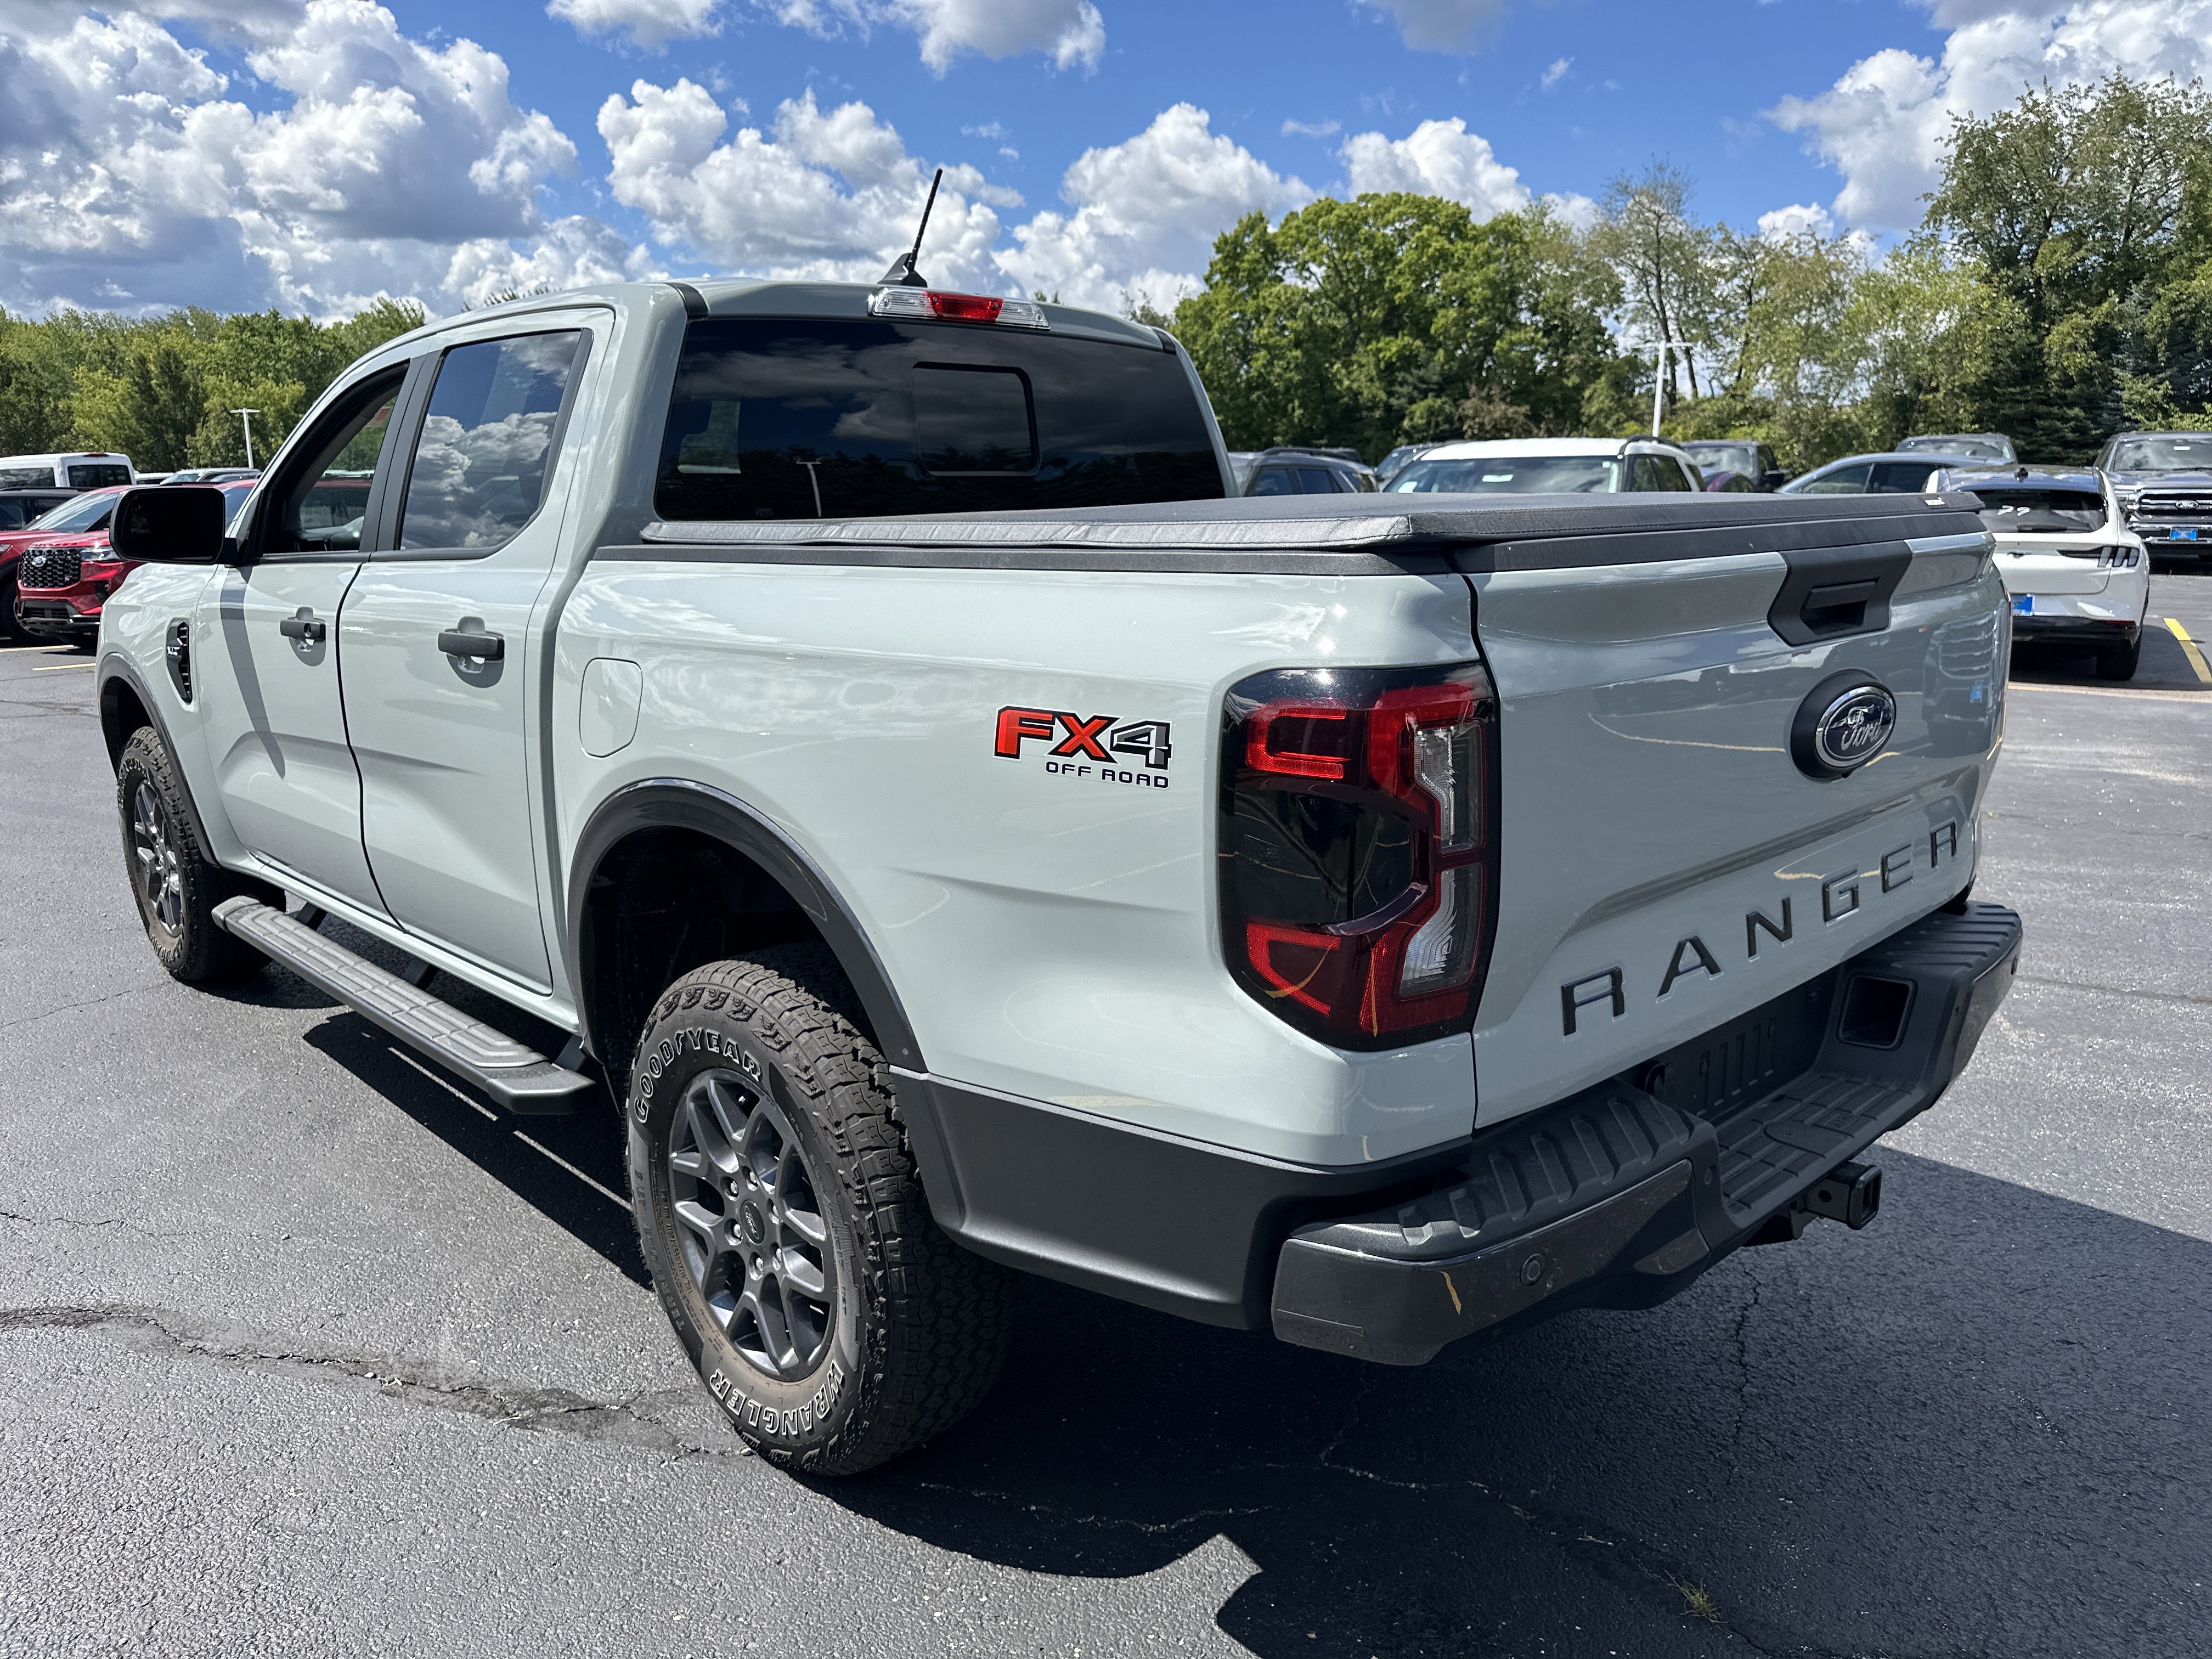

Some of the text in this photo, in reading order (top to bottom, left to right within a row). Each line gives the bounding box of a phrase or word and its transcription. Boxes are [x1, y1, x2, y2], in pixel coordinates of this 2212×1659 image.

[994, 705, 1172, 770] FX4
[1841, 704, 1883, 751] Ford
[1046, 761, 1169, 788] OFF ROAD
[1560, 821, 1957, 1036] RANGER
[635, 1027, 763, 1124] GOODYEAR
[710, 1358, 845, 1437] WRANGLER
